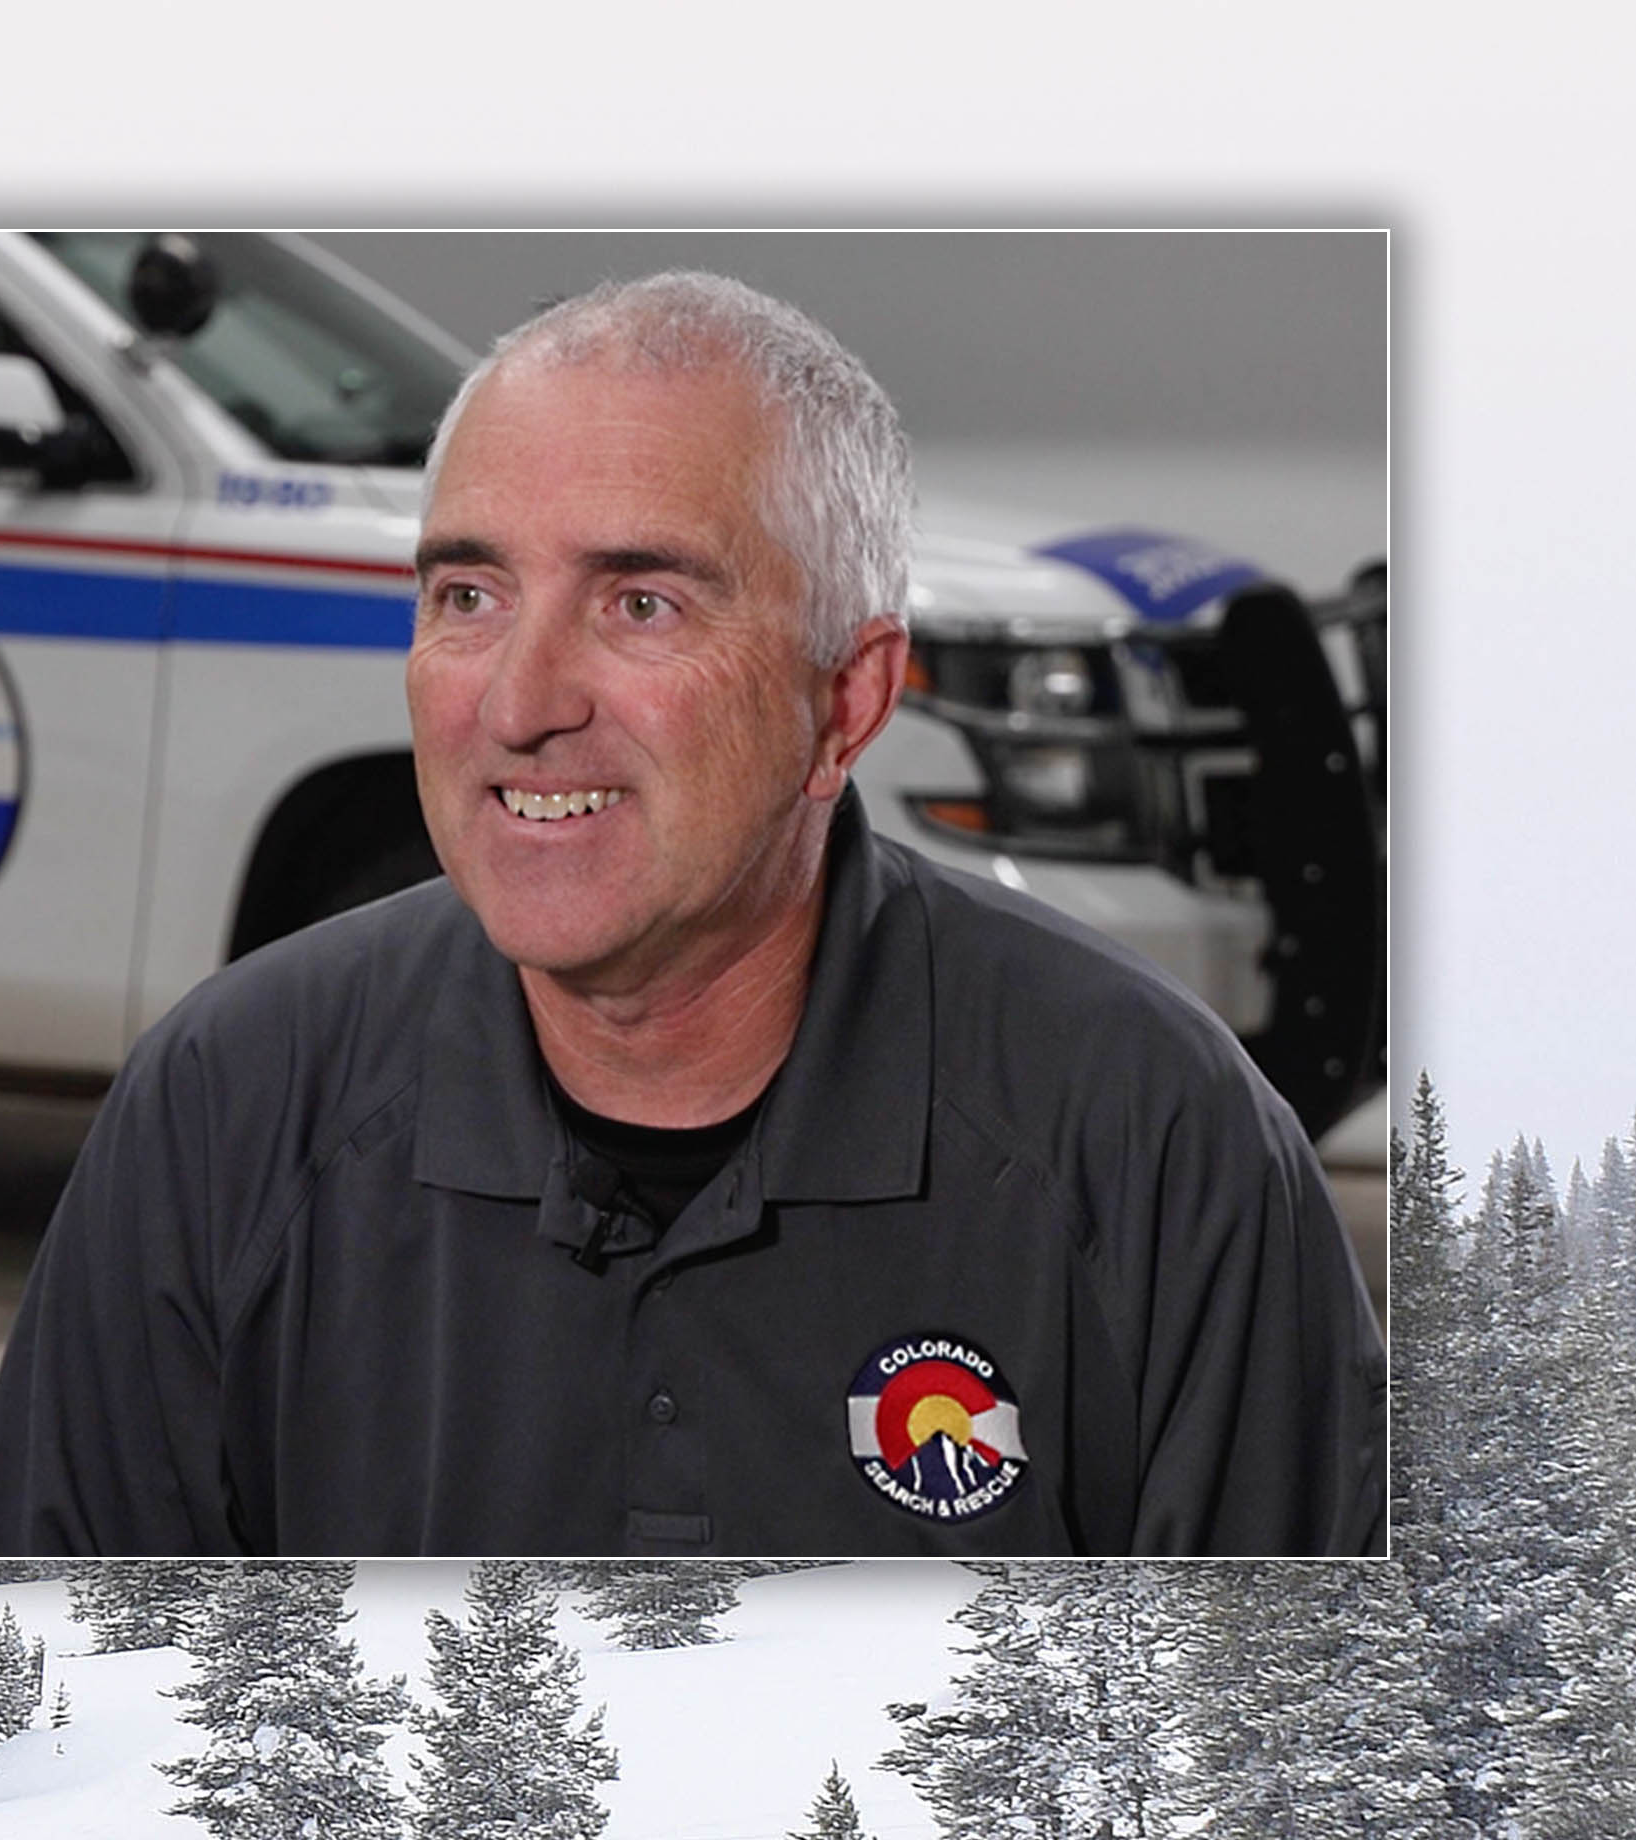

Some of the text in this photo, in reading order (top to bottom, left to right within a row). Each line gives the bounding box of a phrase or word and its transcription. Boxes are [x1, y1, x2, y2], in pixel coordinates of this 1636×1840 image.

[879, 1340, 994, 1379] COLORADO
[864, 1460, 935, 1516] SEARCH
[953, 1460, 1020, 1516] RESCUE
